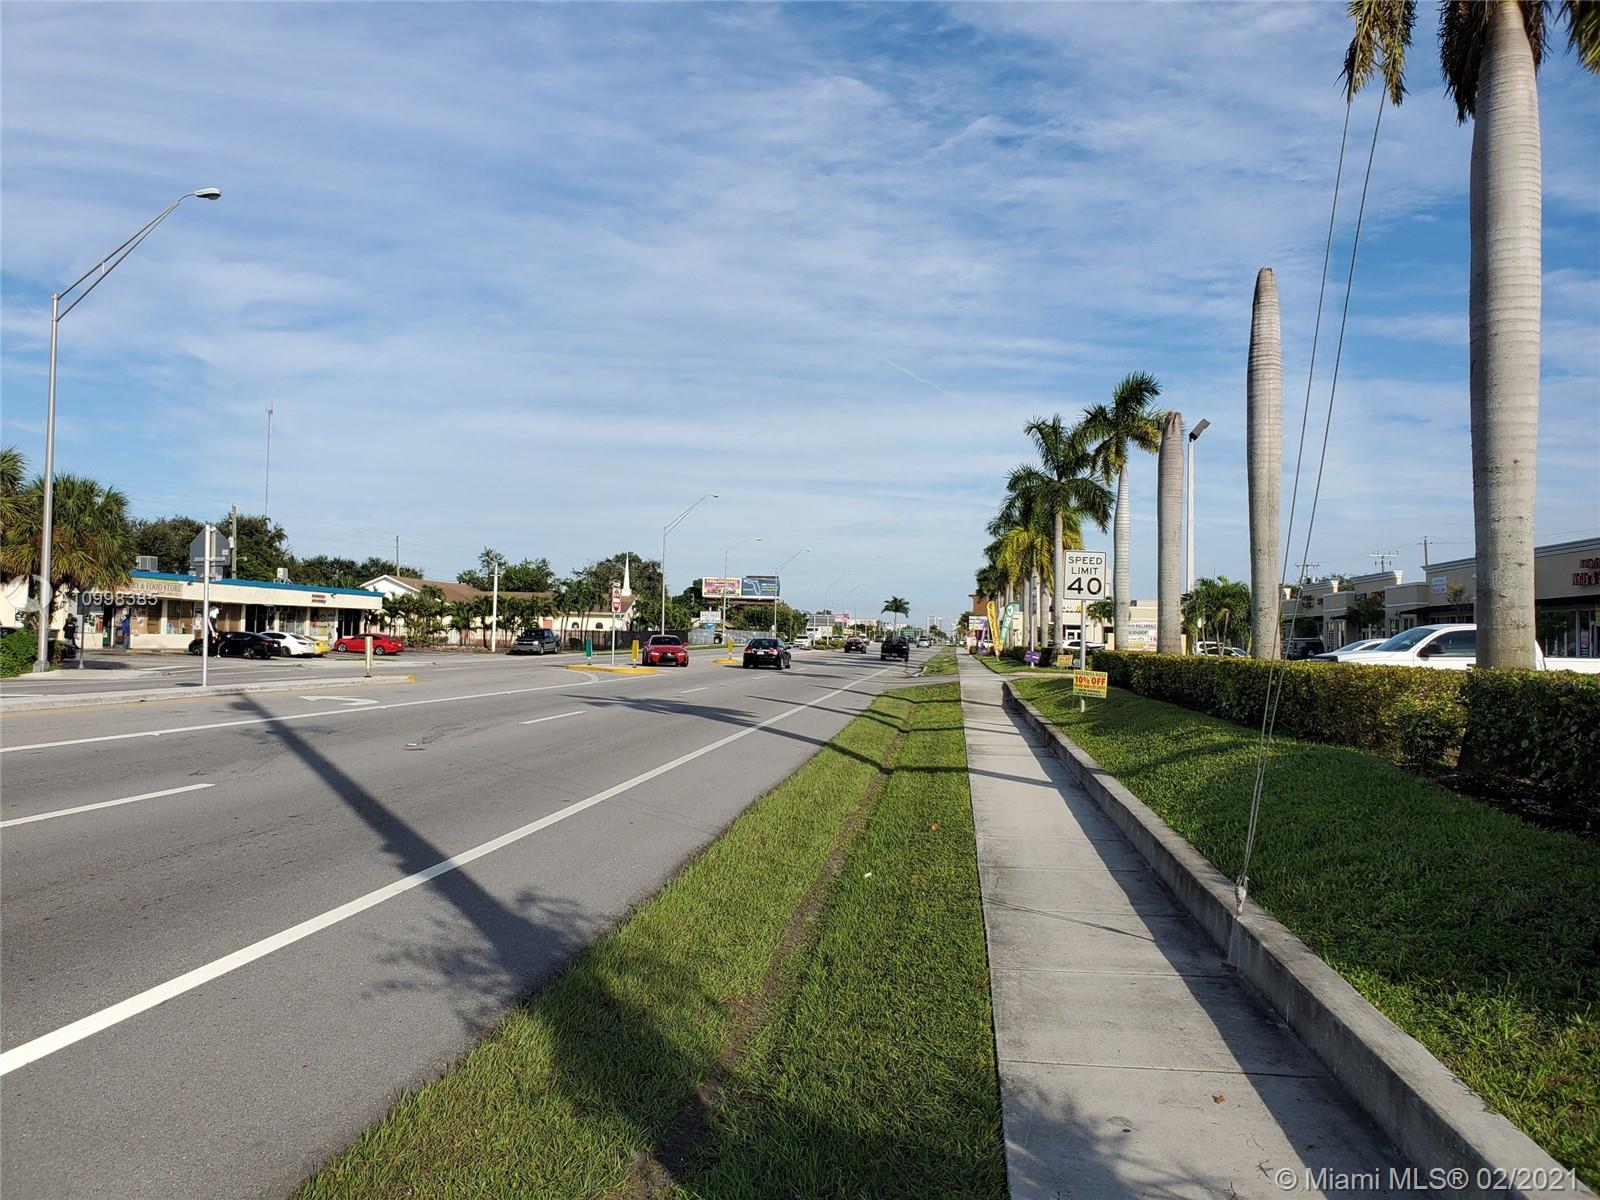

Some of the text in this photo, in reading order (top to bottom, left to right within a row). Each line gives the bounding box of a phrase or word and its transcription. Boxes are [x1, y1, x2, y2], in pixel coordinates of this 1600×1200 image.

[1068, 556, 1103, 565] SPEED
[1071, 567, 1099, 575] LIMIT
[146, 583, 162, 591] FOOD
[163, 584, 183, 592] STORE
[1067, 577, 1102, 595] 40
[1075, 676, 1106, 685] 10% OFF
